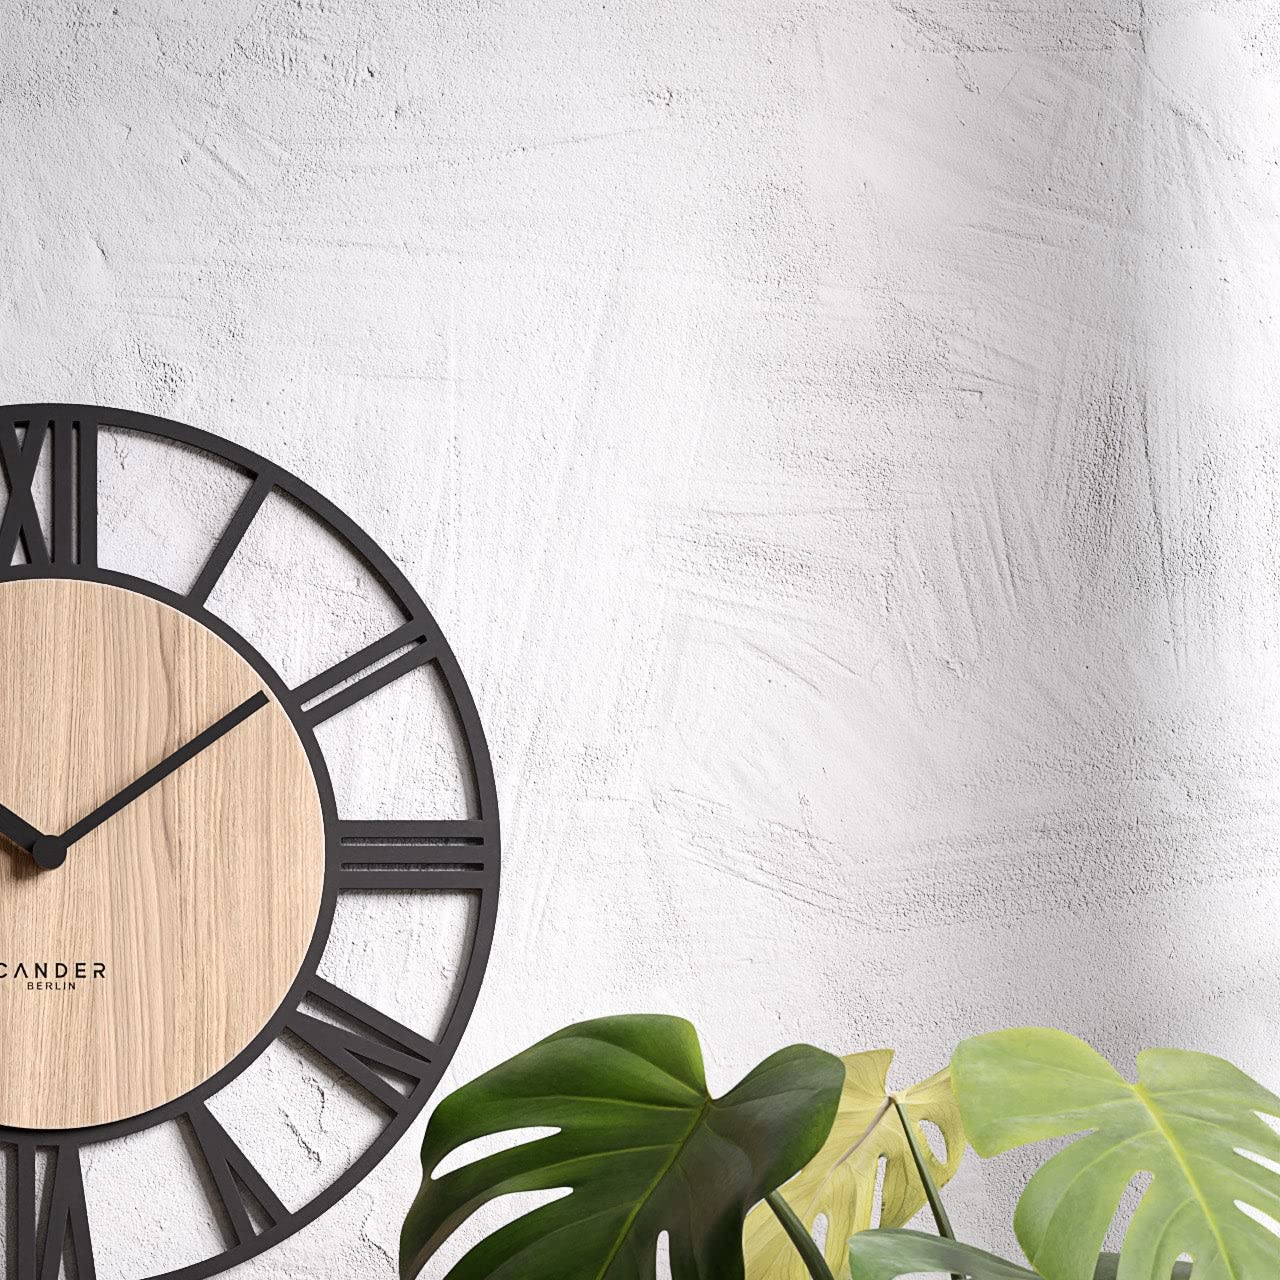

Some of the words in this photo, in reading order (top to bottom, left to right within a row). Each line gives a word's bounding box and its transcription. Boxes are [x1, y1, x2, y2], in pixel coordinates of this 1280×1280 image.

[289, 619, 439, 730] II
[337, 820, 486, 892] III
[27, 981, 76, 991] BERLIN
[284, 976, 442, 1115] IV
[186, 1102, 293, 1248] V
